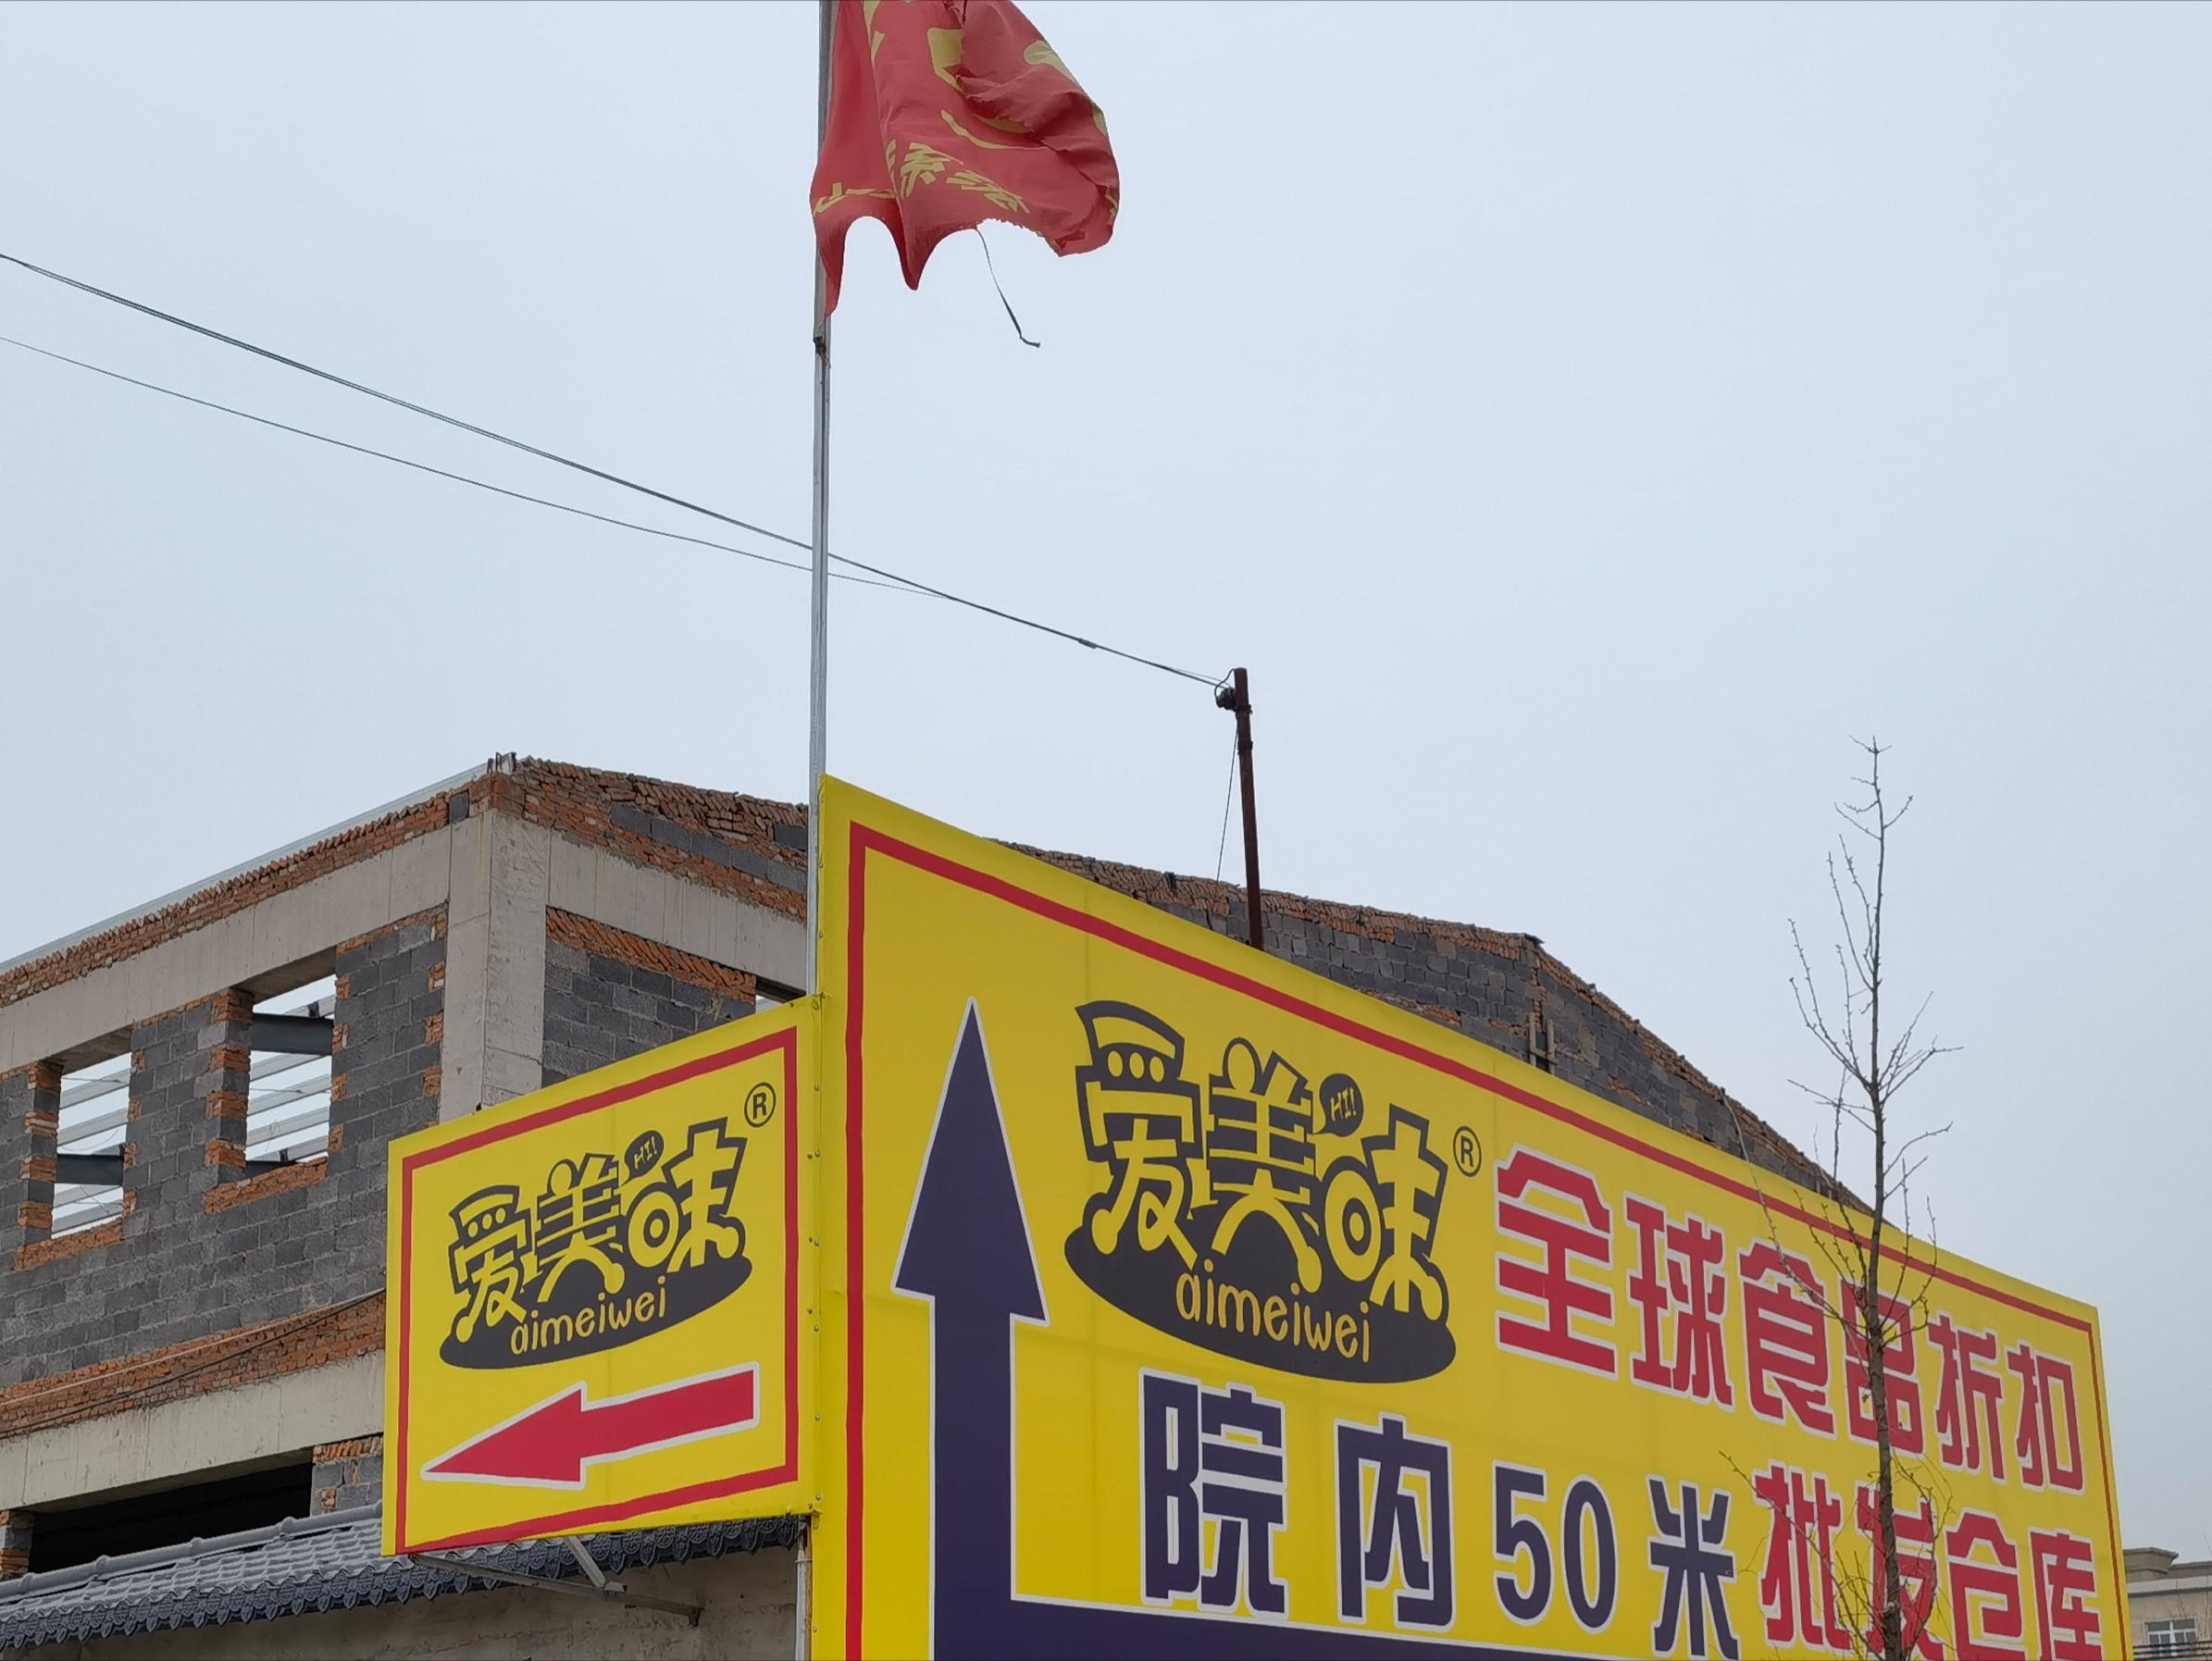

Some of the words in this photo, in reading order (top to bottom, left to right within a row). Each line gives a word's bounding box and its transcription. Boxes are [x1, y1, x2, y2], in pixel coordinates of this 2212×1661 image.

[1329, 1085, 1357, 1122] HI!
[632, 1135, 658, 1171] HI!
[510, 1274, 667, 1355] aimeiwei
[1176, 1259, 1371, 1364] aimeiwei
[1497, 1148, 2084, 1493] 全球食品折扣
[1755, 1465, 2105, 1661] 批发仓库
